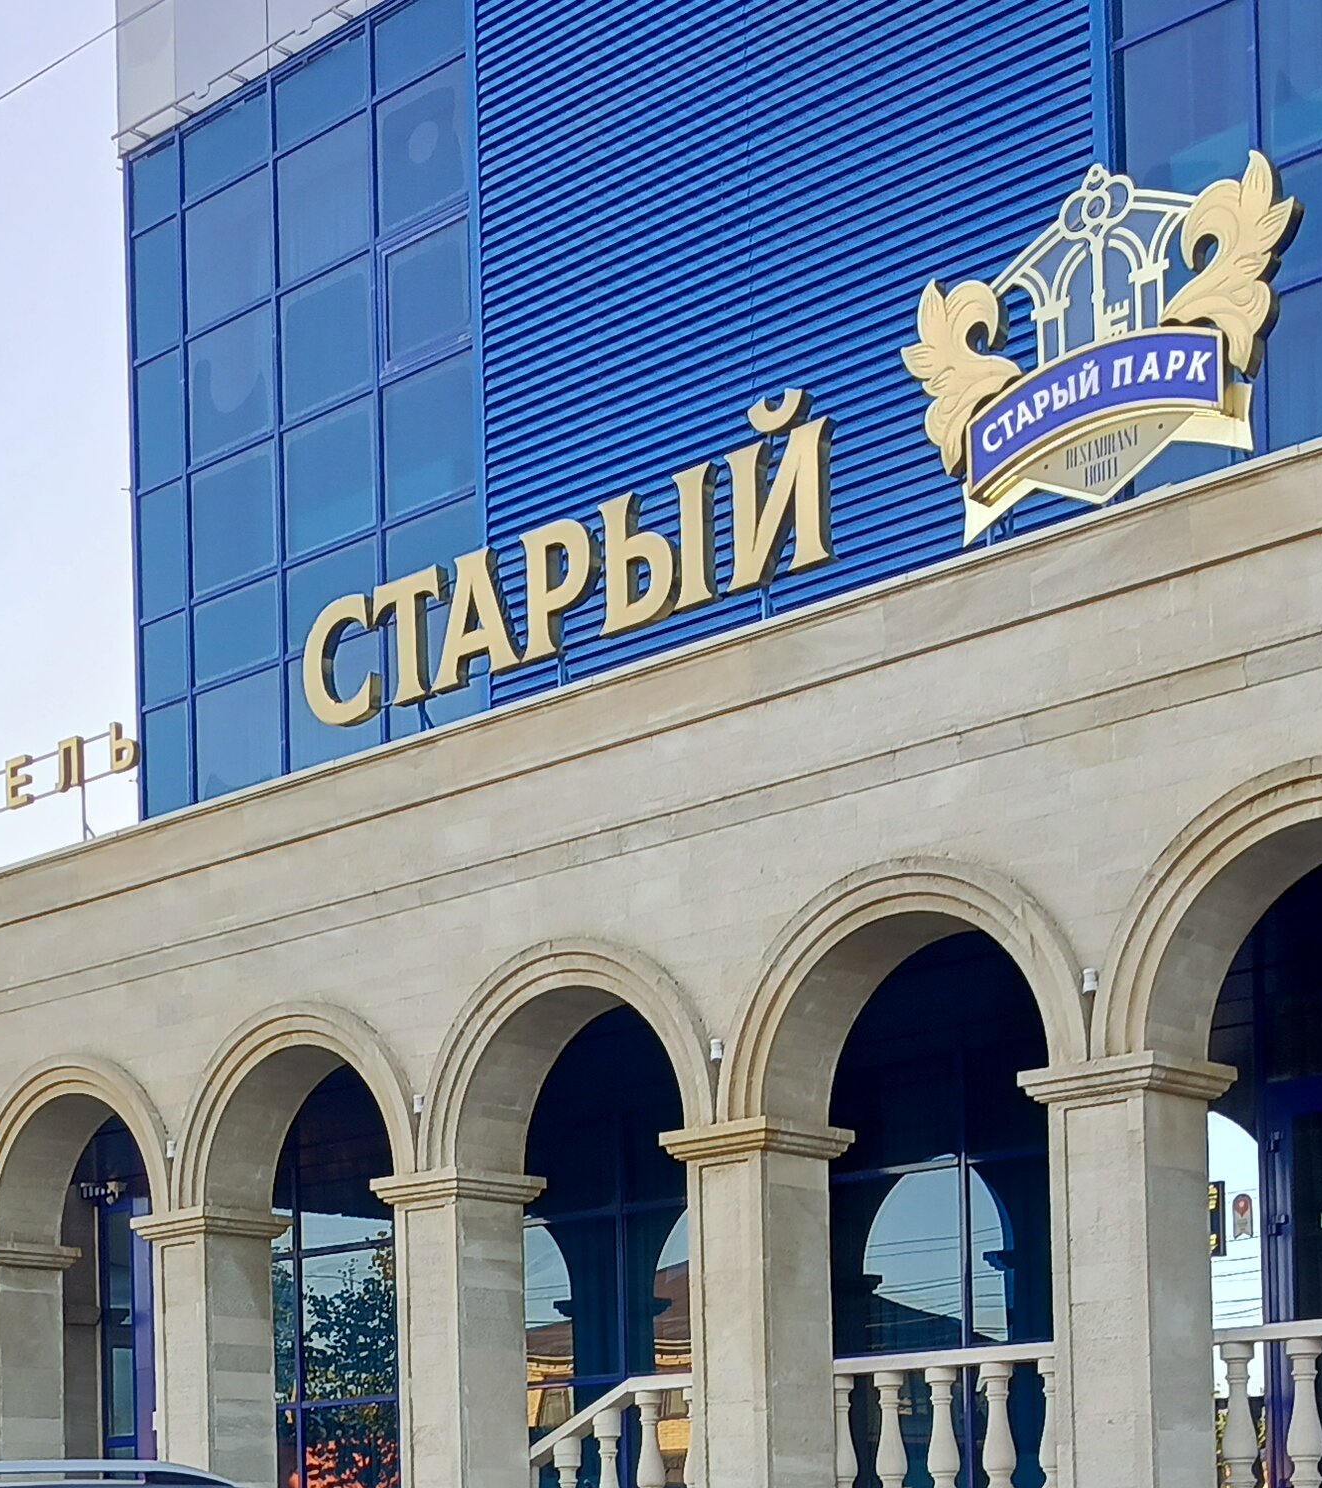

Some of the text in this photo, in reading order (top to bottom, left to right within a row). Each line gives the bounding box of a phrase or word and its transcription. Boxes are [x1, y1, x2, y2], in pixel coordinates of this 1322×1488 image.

[981, 350, 1212, 453] СТАРЫЙ ПАРК
[301, 388, 837, 729] СТАРЫЙ
